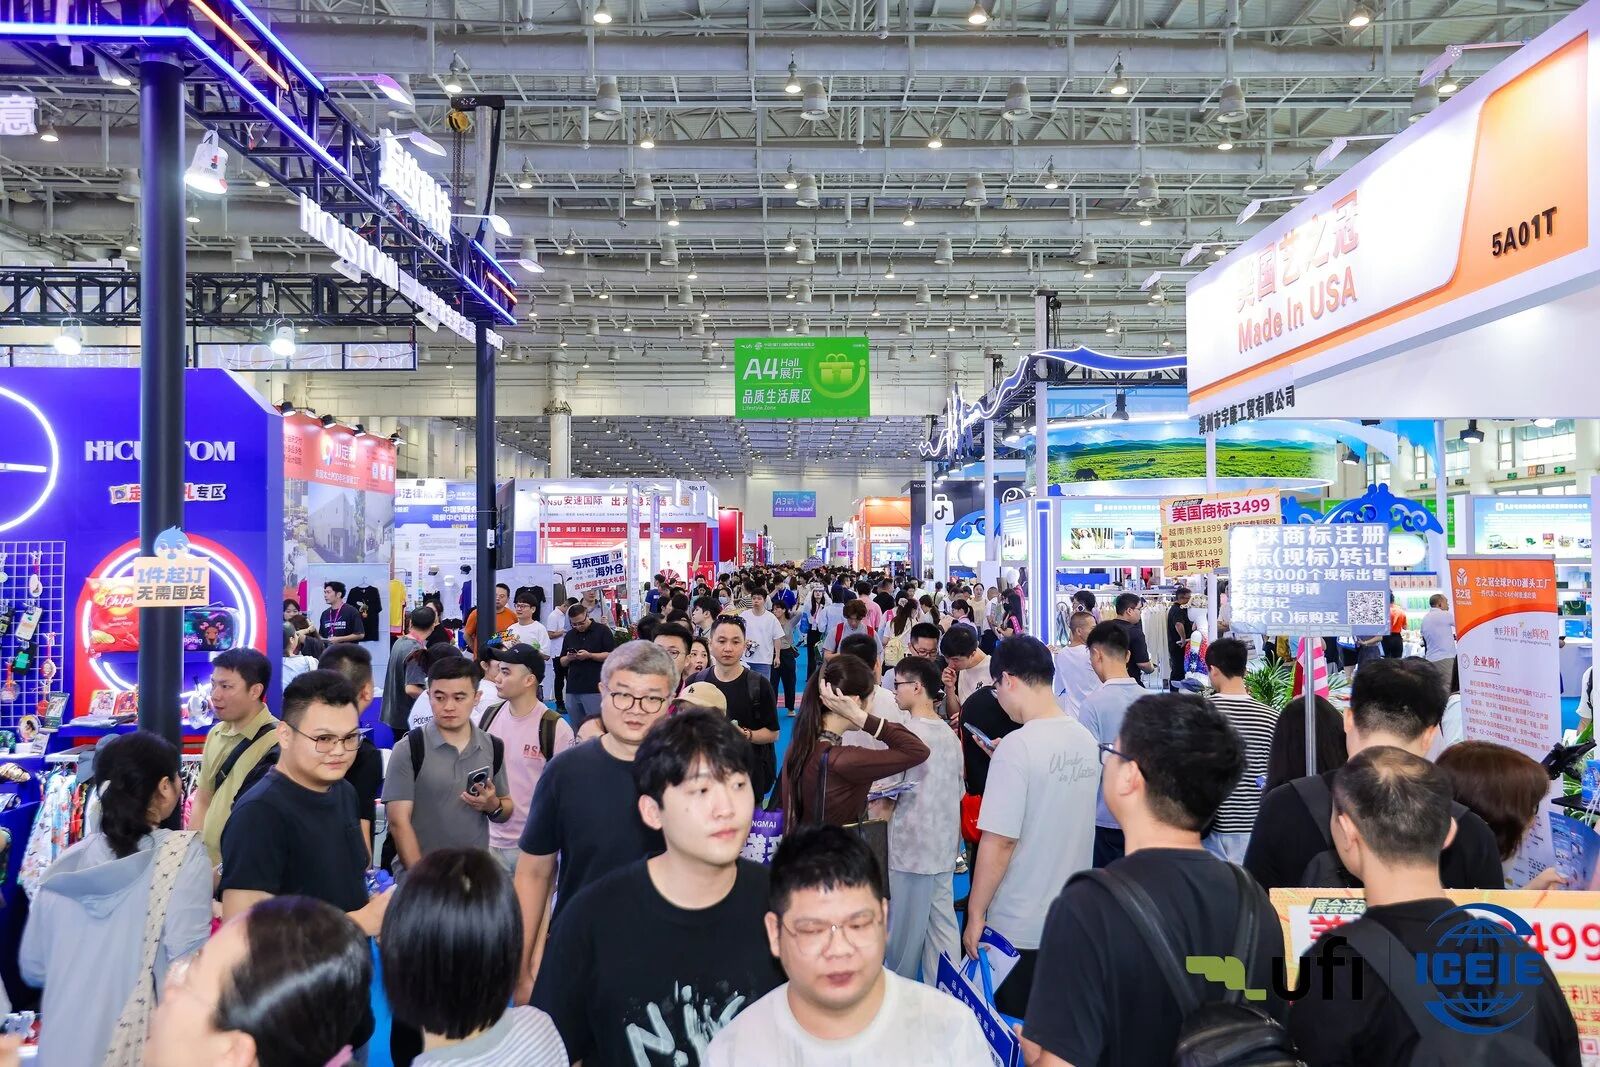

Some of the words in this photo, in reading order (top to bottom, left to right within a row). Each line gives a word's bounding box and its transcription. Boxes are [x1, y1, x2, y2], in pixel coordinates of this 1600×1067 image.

[1492, 206, 1557, 256] 5A01T
[1238, 308, 1283, 354] Made
[1287, 297, 1304, 331] In
[1310, 266, 1358, 320] USA
[742, 358, 778, 380] A4
[781, 358, 799, 367] Hall
[780, 368, 803, 379] 展厅
[742, 389, 812, 404] 品质生活展区
[564, 495, 603, 505] 安速国际
[1172, 498, 1270, 523] 美国商标3499
[1168, 525, 1221, 536] 越南商标1899
[1242, 525, 1385, 545] 球商标注册
[572, 554, 610, 569] 马来西亚
[1170, 558, 1220, 572] 海量一手R标
[137, 567, 205, 584] 1件起订
[595, 563, 623, 578] 海外仓
[136, 585, 206, 600] 无需囤货
[1473, 656, 1500, 669] 企业简介
